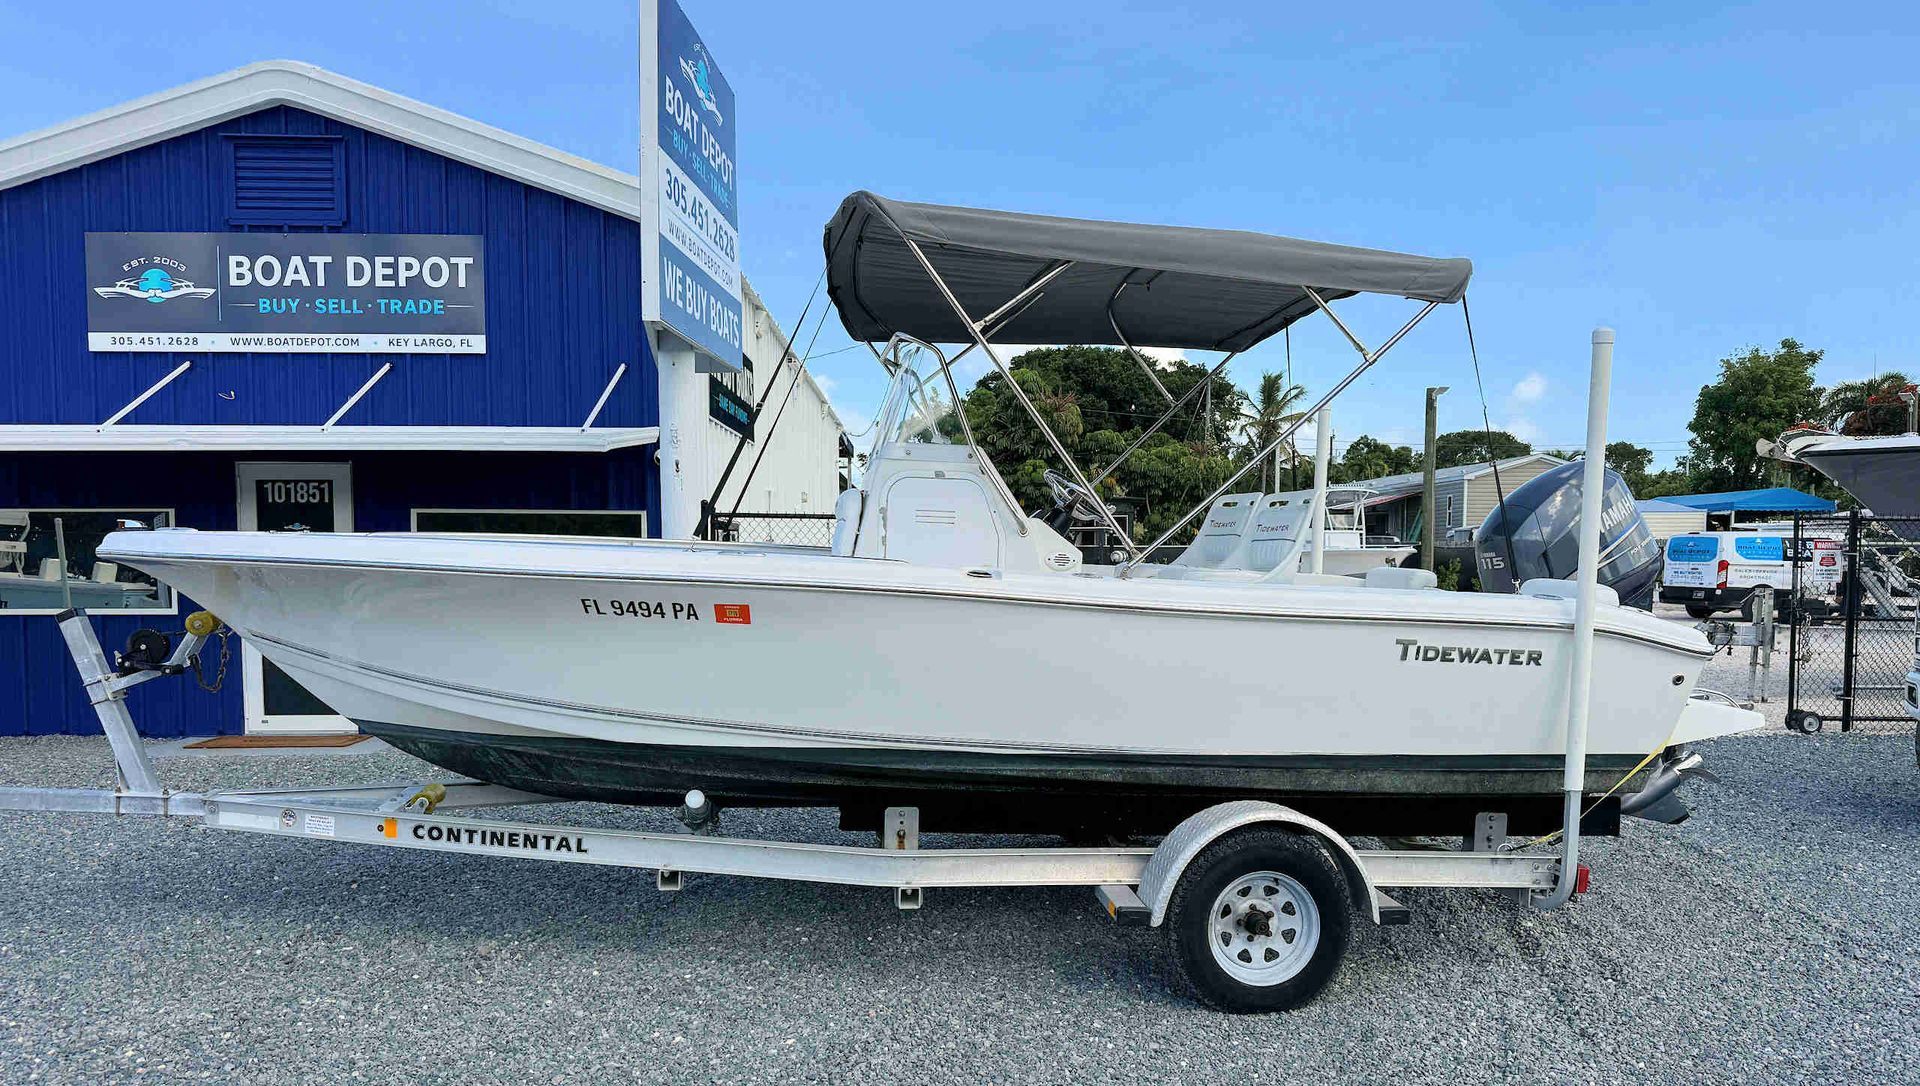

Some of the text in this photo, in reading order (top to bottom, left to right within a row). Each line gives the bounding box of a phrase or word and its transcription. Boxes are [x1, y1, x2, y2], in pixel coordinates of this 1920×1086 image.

[665, 74, 734, 191] BOAT DEPOT
[672, 129, 689, 160] BUY
[692, 156, 708, 184] SELL
[665, 167, 736, 262] 305.451.2628
[122, 256, 187, 272] EST. 2003
[228, 255, 474, 288] BOAT DEPOT
[258, 298, 445, 315] BUY SELL TRADE
[663, 256, 740, 349] WE BUY BOATS
[110, 336, 473, 349] 305.451.2628 WWW.BOATDEPOT.COM KEY LARGO, FL
[263, 482, 329, 503] 101851
[1256, 523, 1290, 533] TIDEWATER
[1481, 557, 1505, 570] 115
[580, 598, 700, 621] FL 9494 PA
[1395, 638, 1543, 667] TIDEWATER
[412, 824, 588, 854] CONTINENTAL
